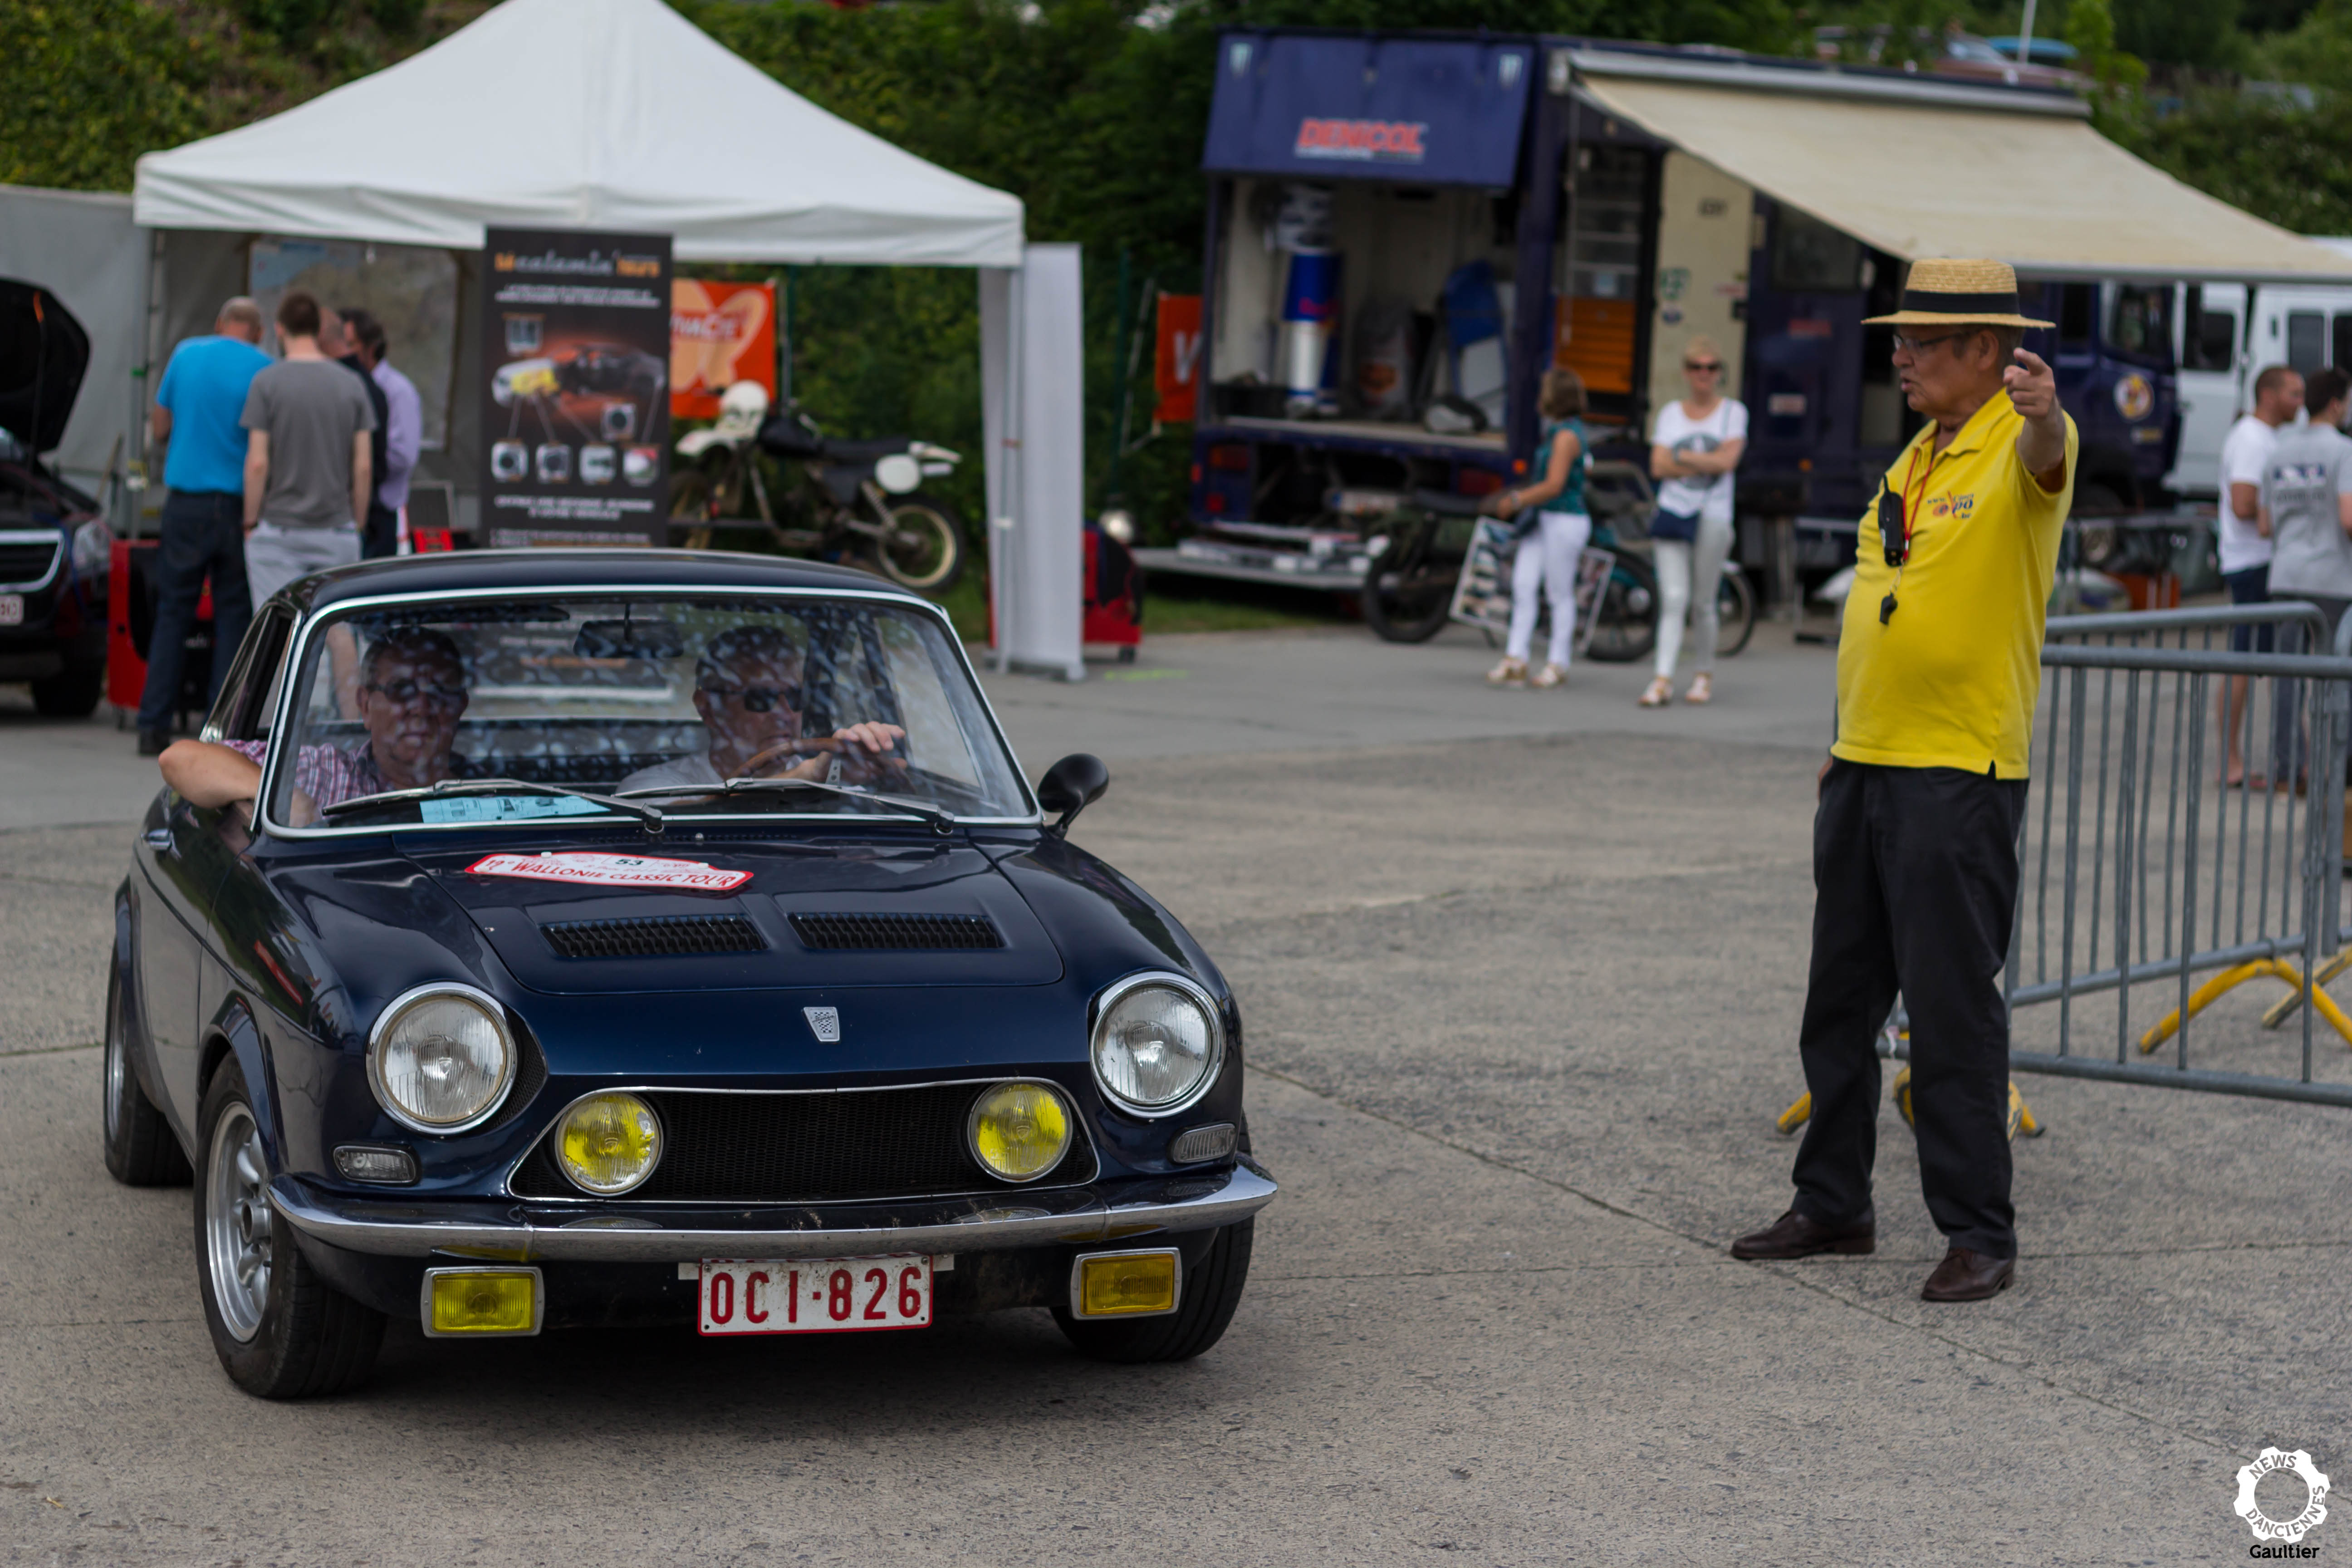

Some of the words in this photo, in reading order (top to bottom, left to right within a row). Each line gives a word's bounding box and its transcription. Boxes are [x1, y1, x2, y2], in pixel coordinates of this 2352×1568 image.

[511, 862, 607, 878] WALLONIE
[609, 873, 682, 882] CLASSIC
[682, 874, 737, 886] TOUR
